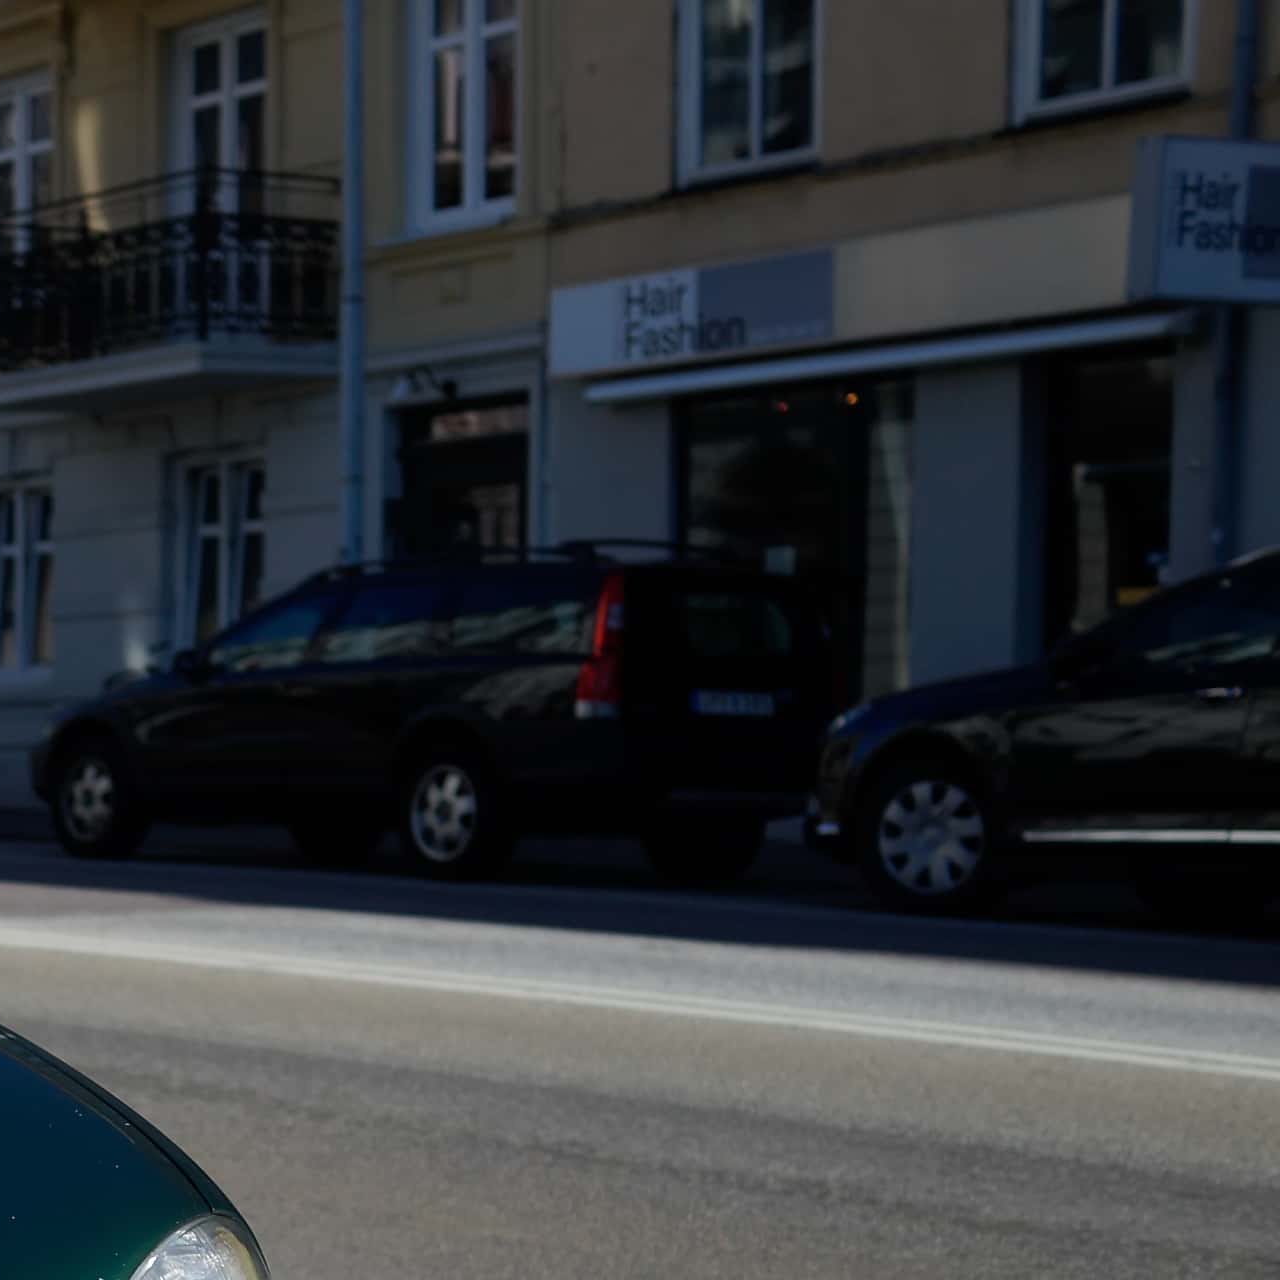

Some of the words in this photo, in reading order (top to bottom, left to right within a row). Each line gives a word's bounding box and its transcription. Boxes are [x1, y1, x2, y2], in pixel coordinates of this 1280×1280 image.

[1176, 171, 1240, 209] Hair
[624, 276, 688, 319] Hair
[624, 313, 747, 360] Fashion
